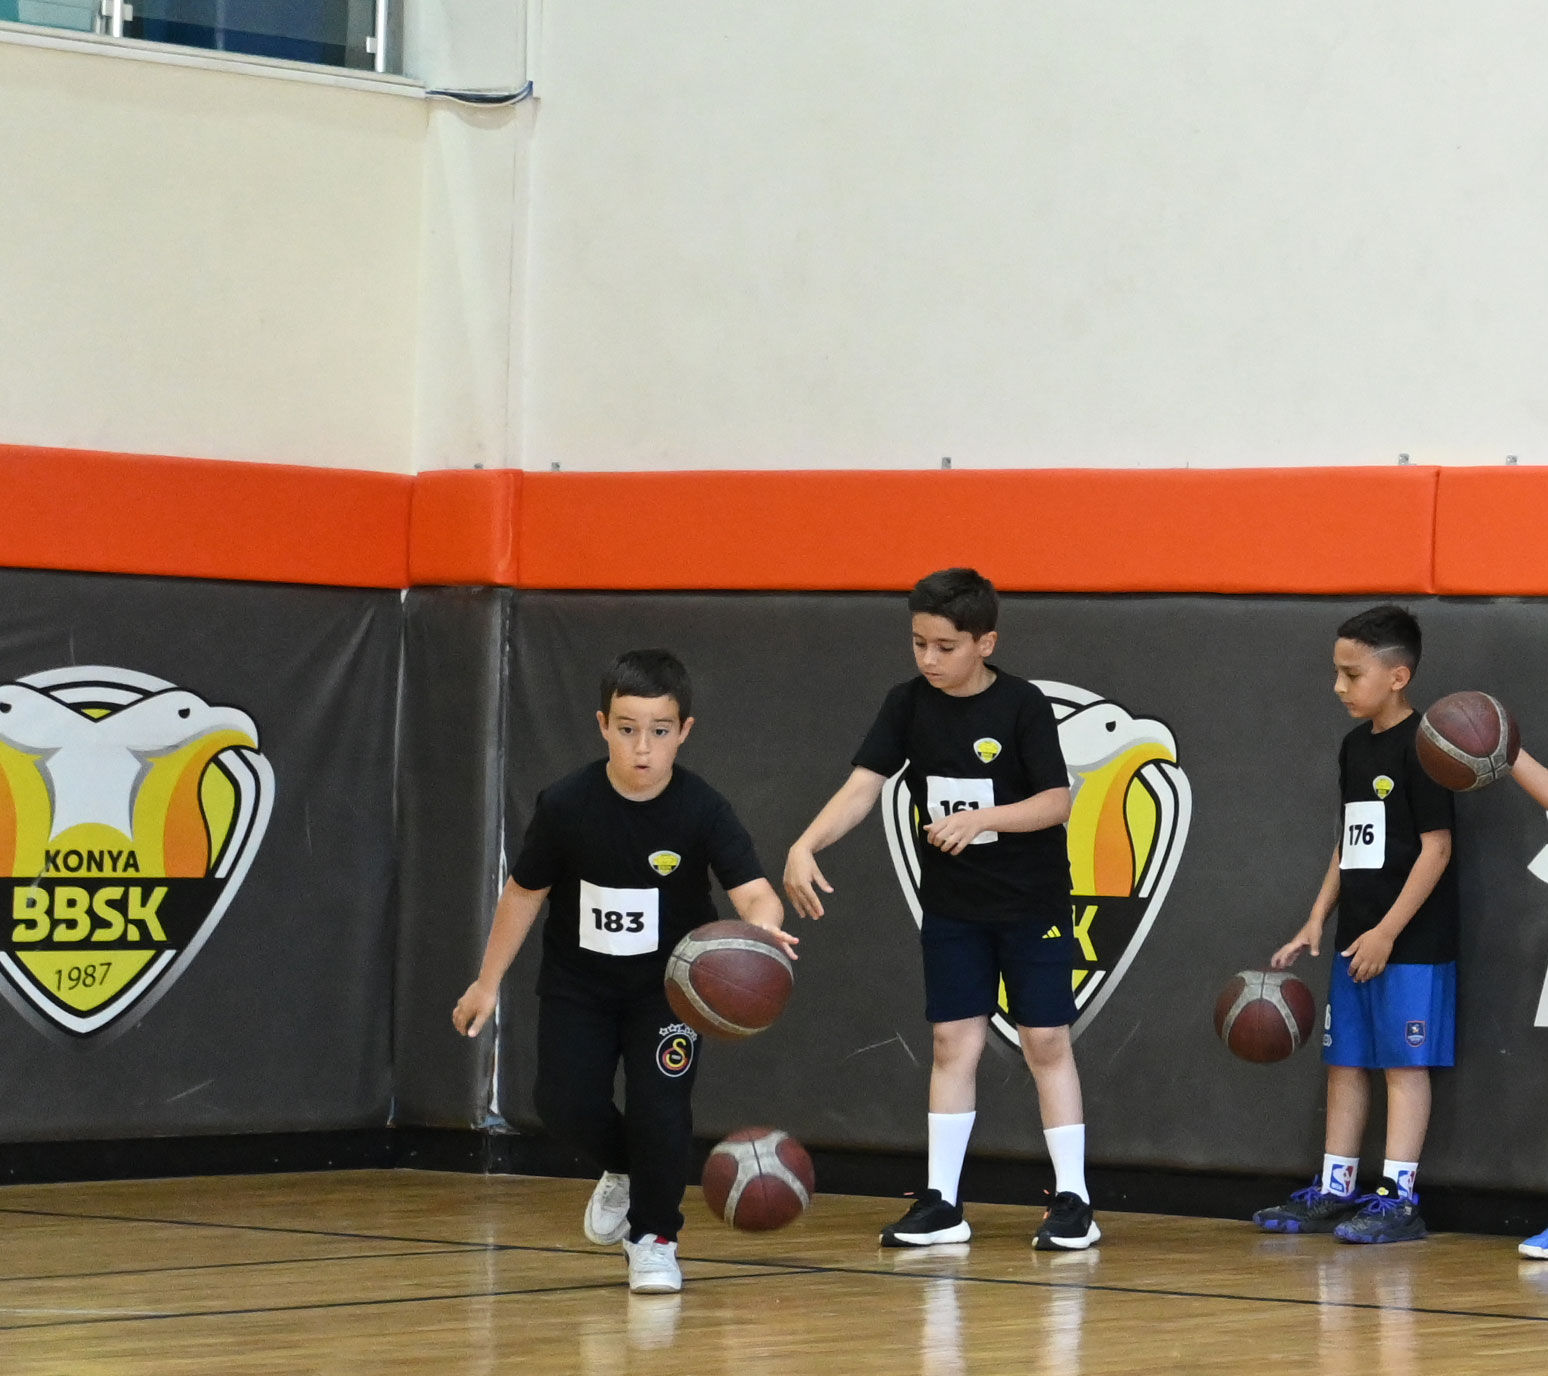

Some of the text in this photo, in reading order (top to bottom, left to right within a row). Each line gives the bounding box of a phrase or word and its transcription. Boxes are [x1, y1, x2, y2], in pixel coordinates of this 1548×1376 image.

[1349, 823, 1374, 846] 176
[44, 849, 140, 873] KONYA
[12, 886, 169, 942] BBSK
[591, 908, 645, 933] 183
[55, 962, 112, 992] 1987
